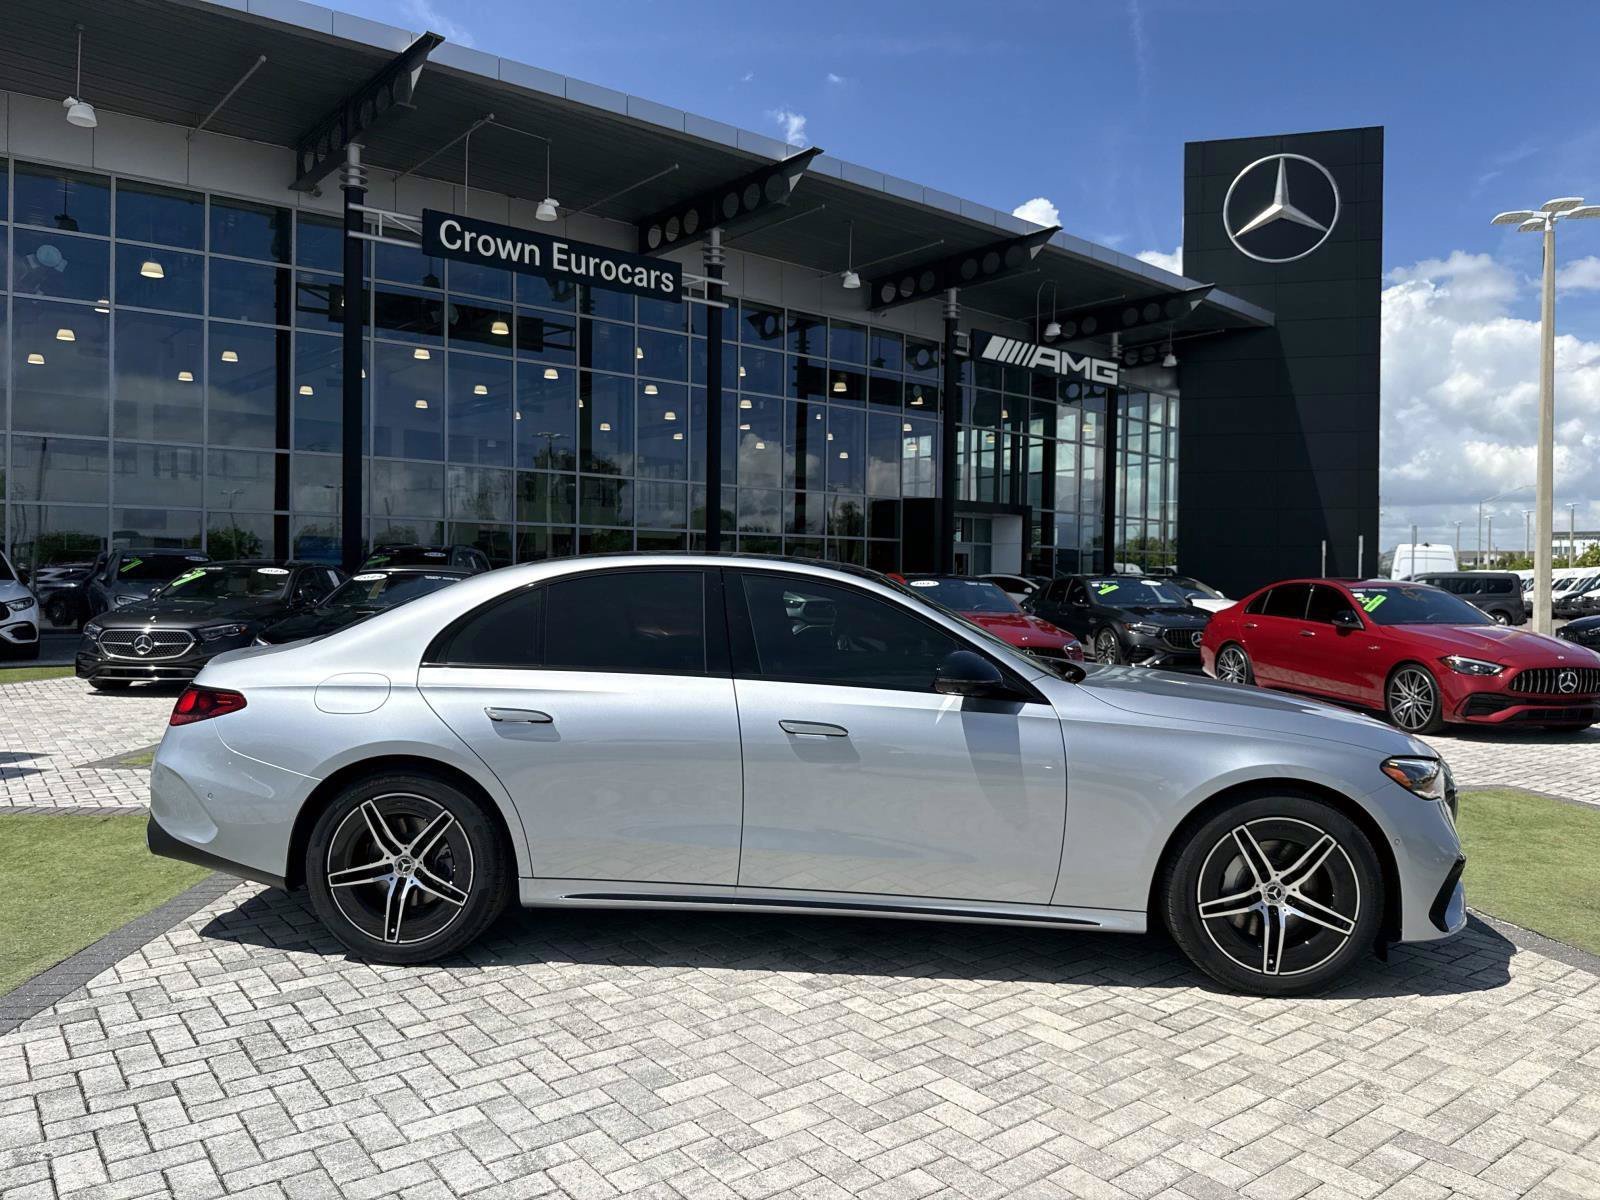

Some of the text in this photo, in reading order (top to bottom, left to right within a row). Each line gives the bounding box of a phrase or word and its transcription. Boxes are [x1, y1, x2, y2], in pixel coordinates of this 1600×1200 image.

[439, 219, 674, 293] Crown Eurocars
[1026, 344, 1119, 386] AMG
